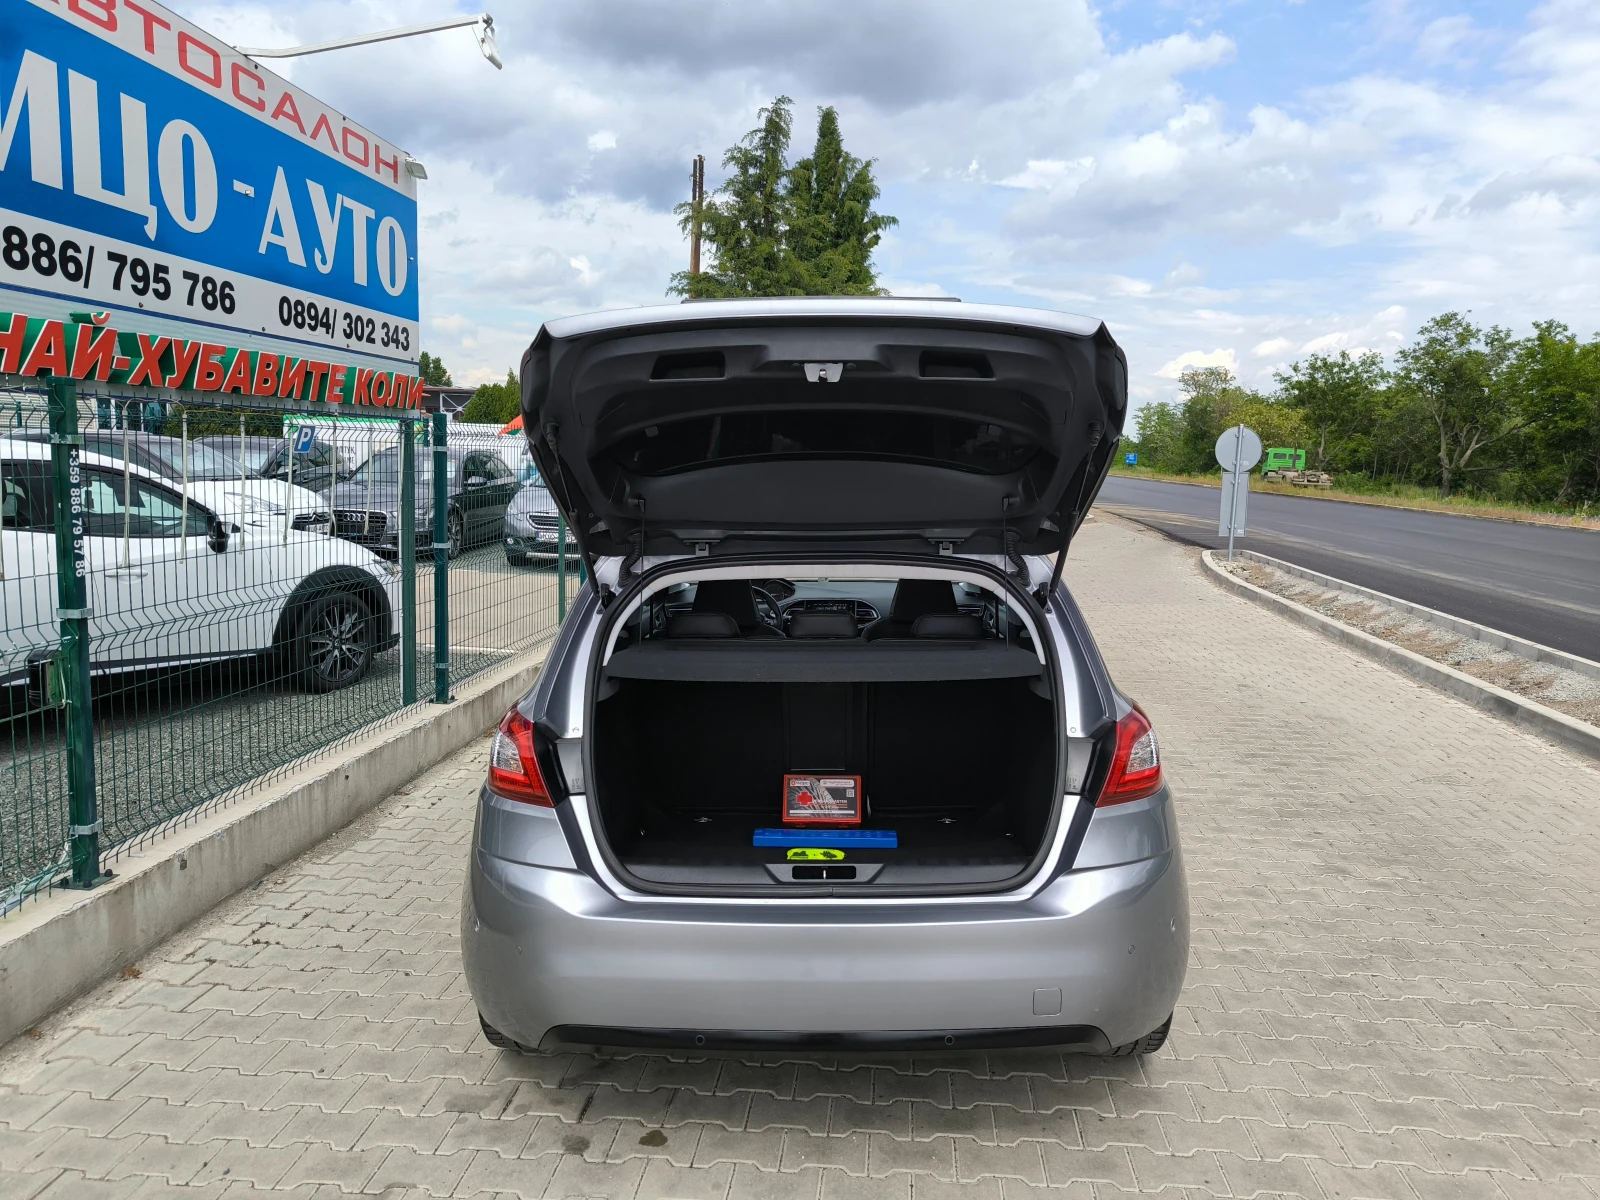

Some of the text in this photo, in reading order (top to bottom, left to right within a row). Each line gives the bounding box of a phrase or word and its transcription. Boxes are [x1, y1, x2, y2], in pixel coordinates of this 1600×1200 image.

[52, 0, 399, 185] ВТОСАЛОН
[107, 251, 171, 301] 795
[182, 270, 236, 315] 786
[343, 312, 376, 344] 302
[381, 322, 410, 351] 343
[352, 367, 425, 410] КОЛИ
[69, 448, 85, 578] +359 886 79 57 86
